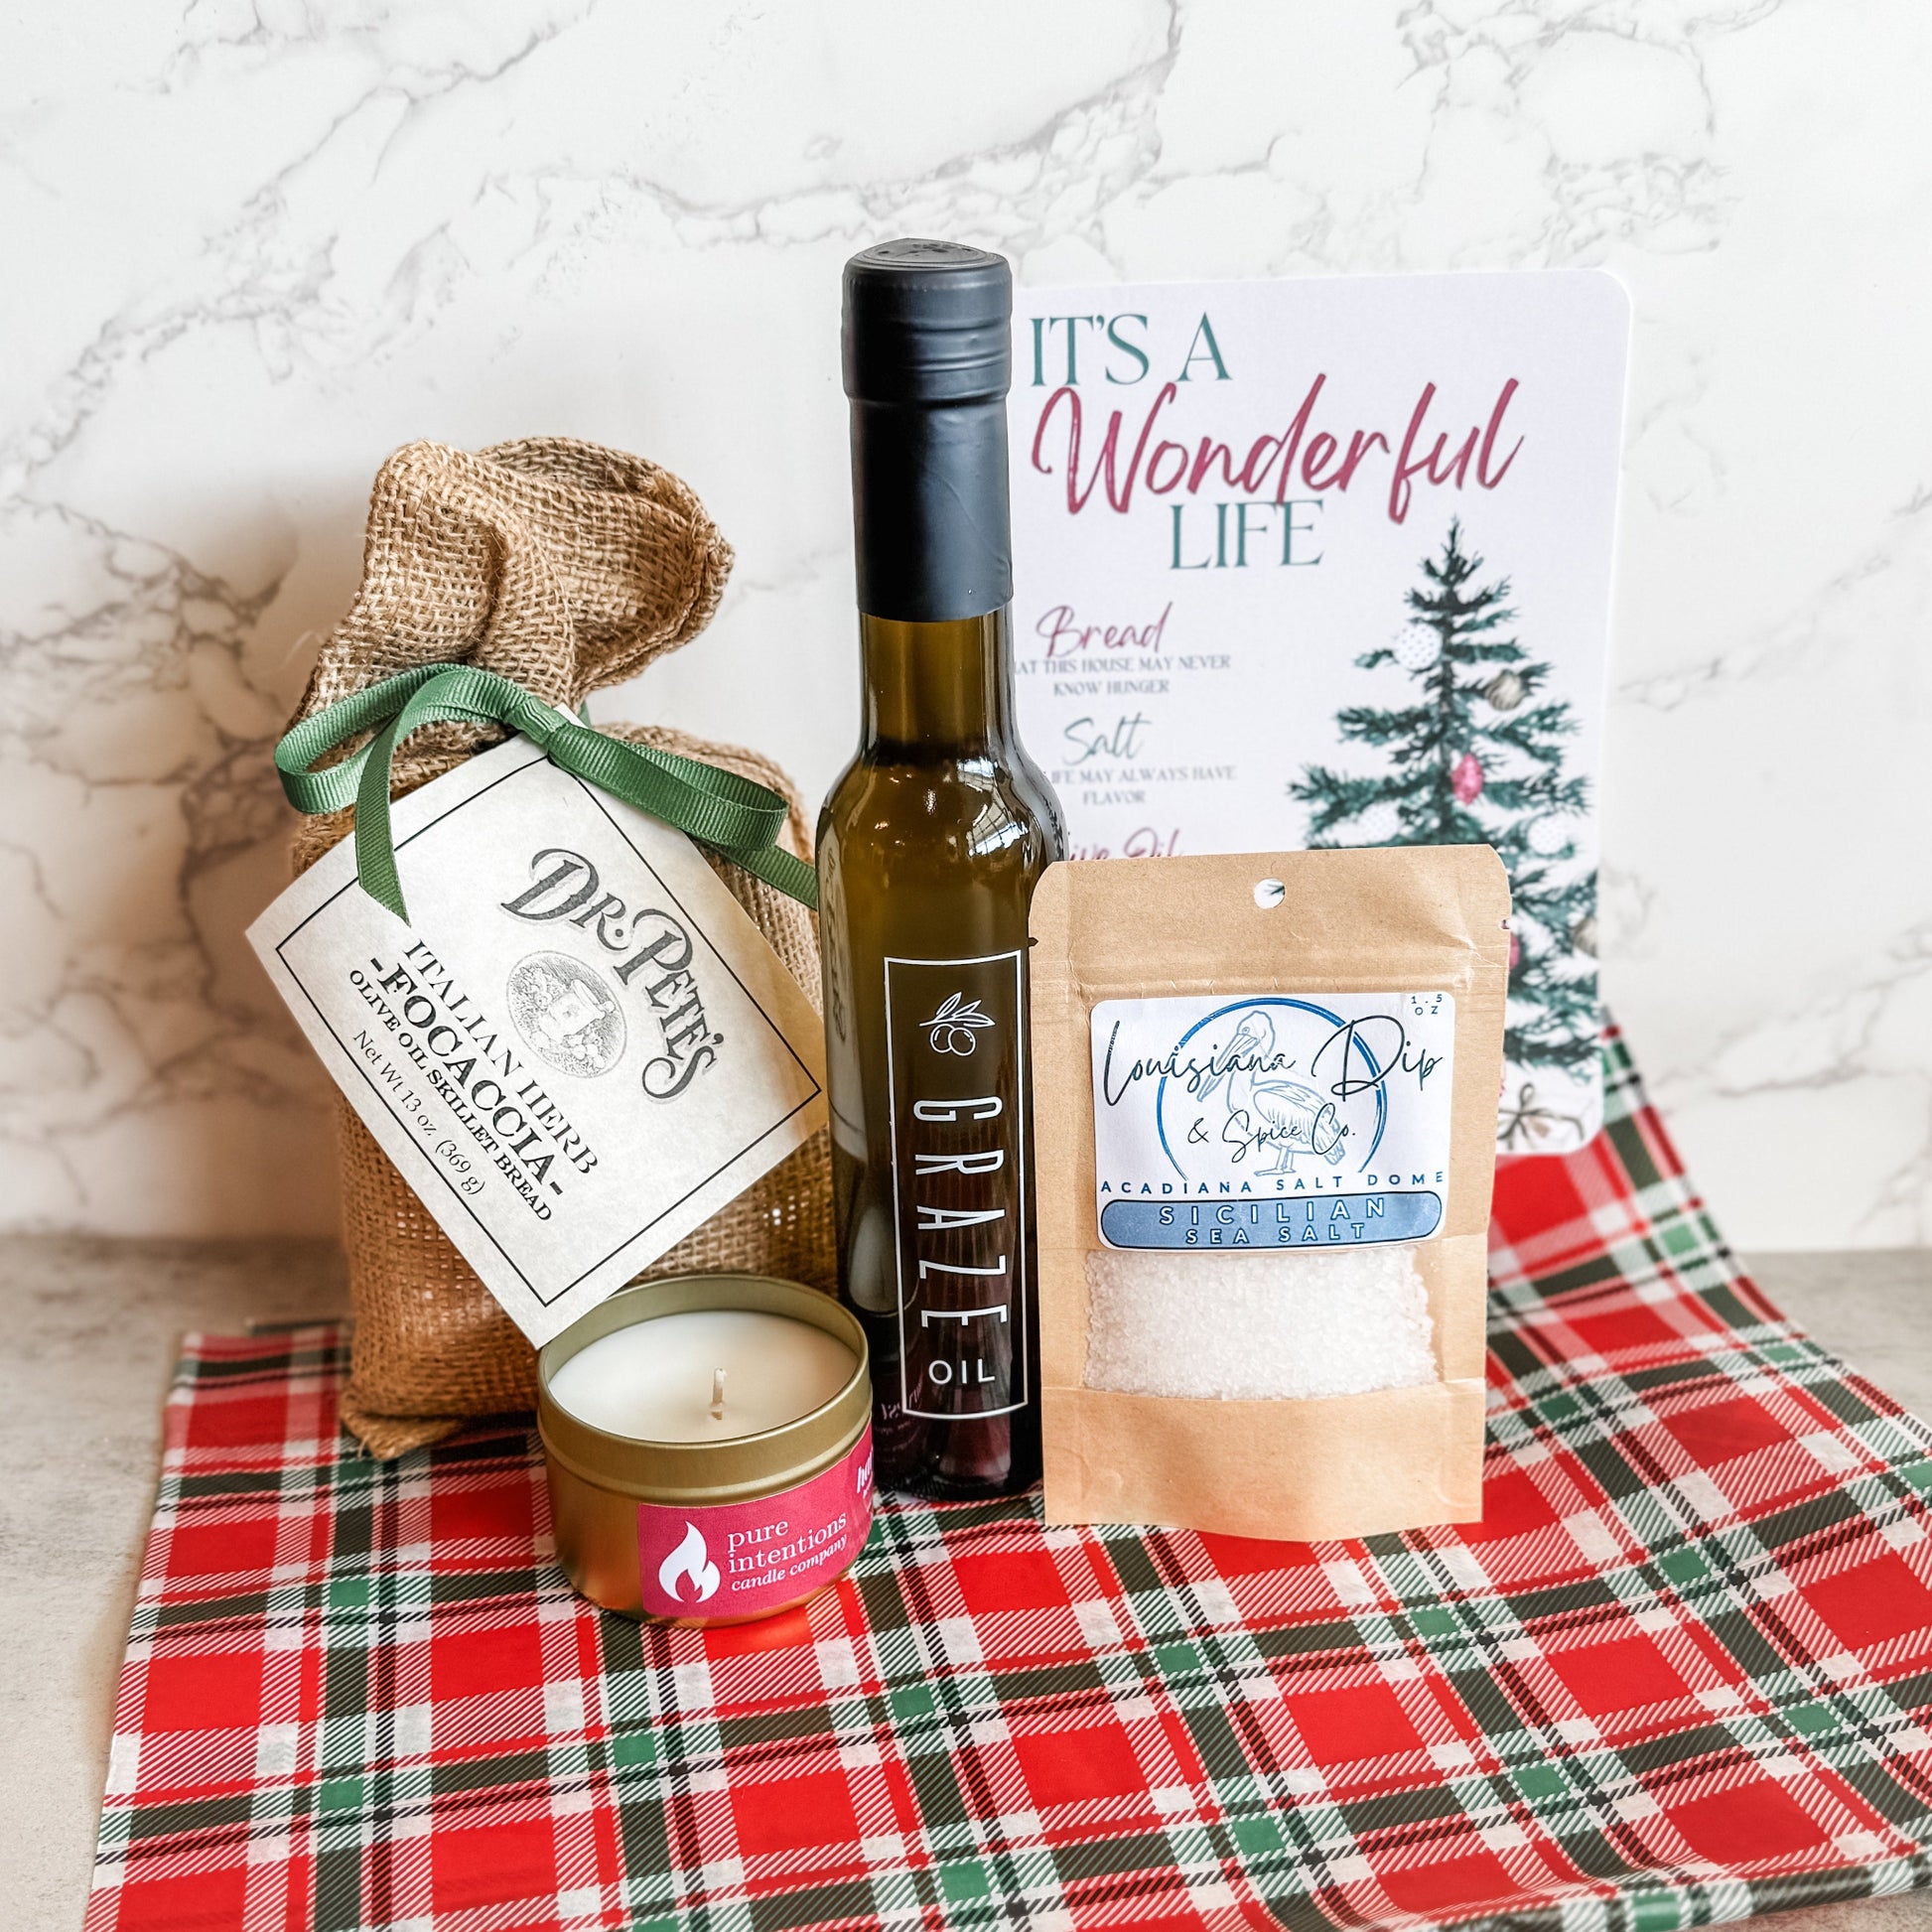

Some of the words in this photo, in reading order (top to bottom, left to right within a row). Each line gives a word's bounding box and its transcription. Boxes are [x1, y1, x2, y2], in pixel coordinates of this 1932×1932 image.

[1031, 314, 1150, 387] IT'S
[1175, 312, 1233, 382] A
[1032, 373, 1525, 525] Wonderful
[1170, 498, 1325, 570] LIFE
[1035, 601, 1173, 658] Bread
[1015, 660, 1039, 675] AT
[1043, 659, 1077, 674] THIS
[1081, 658, 1134, 672] HOUSE
[1139, 656, 1174, 672] MAY
[1177, 654, 1232, 670] NEVER
[1053, 681, 1102, 696] KNOW
[1106, 679, 1171, 694] HUNGER
[1063, 712, 1152, 766] Salt
[1051, 769, 1074, 784] IFE
[1079, 768, 1115, 783] MAY
[1119, 766, 1188, 782] ALWAYS
[1191, 765, 1237, 781] HAVE
[1083, 790, 1147, 805] FLAVOR
[402, 938, 524, 1077] ITALIAN
[516, 1078, 598, 1173] HERB
[1104, 1020, 1296, 1106] Louisiana
[1311, 1015, 1443, 1102] Dip
[349, 970, 401, 1033] OLIVE
[398, 1033, 429, 1070] OIL
[426, 1069, 499, 1154] SKILLET
[493, 1152, 552, 1220] BREAD
[353, 1030, 382, 1065] Net
[380, 1062, 404, 1092] Wt
[401, 1089, 422, 1112] 13
[417, 1114, 437, 1136] oz
[435, 1140, 472, 1173] (369
[461, 1176, 485, 1194] g)
[1186, 1117, 1210, 1144] &
[1221, 1109, 1303, 1164] Spice
[1311, 1102, 1356, 1156] Co.
[1101, 1179, 1253, 1194] ACADIANA
[1276, 1175, 1343, 1190] SALT
[1367, 1171, 1444, 1186] DOME
[912, 1096, 1008, 1327] GRAZE
[1159, 1197, 1386, 1226] SICILIAN
[1184, 1227, 1251, 1245] SEA
[1279, 1222, 1365, 1241] SALT
[928, 1359, 996, 1385] OIL
[728, 1520, 788, 1553] pure
[729, 1512, 847, 1574] intentions
[731, 1569, 786, 1591] candle
[789, 1534, 847, 1576] company
